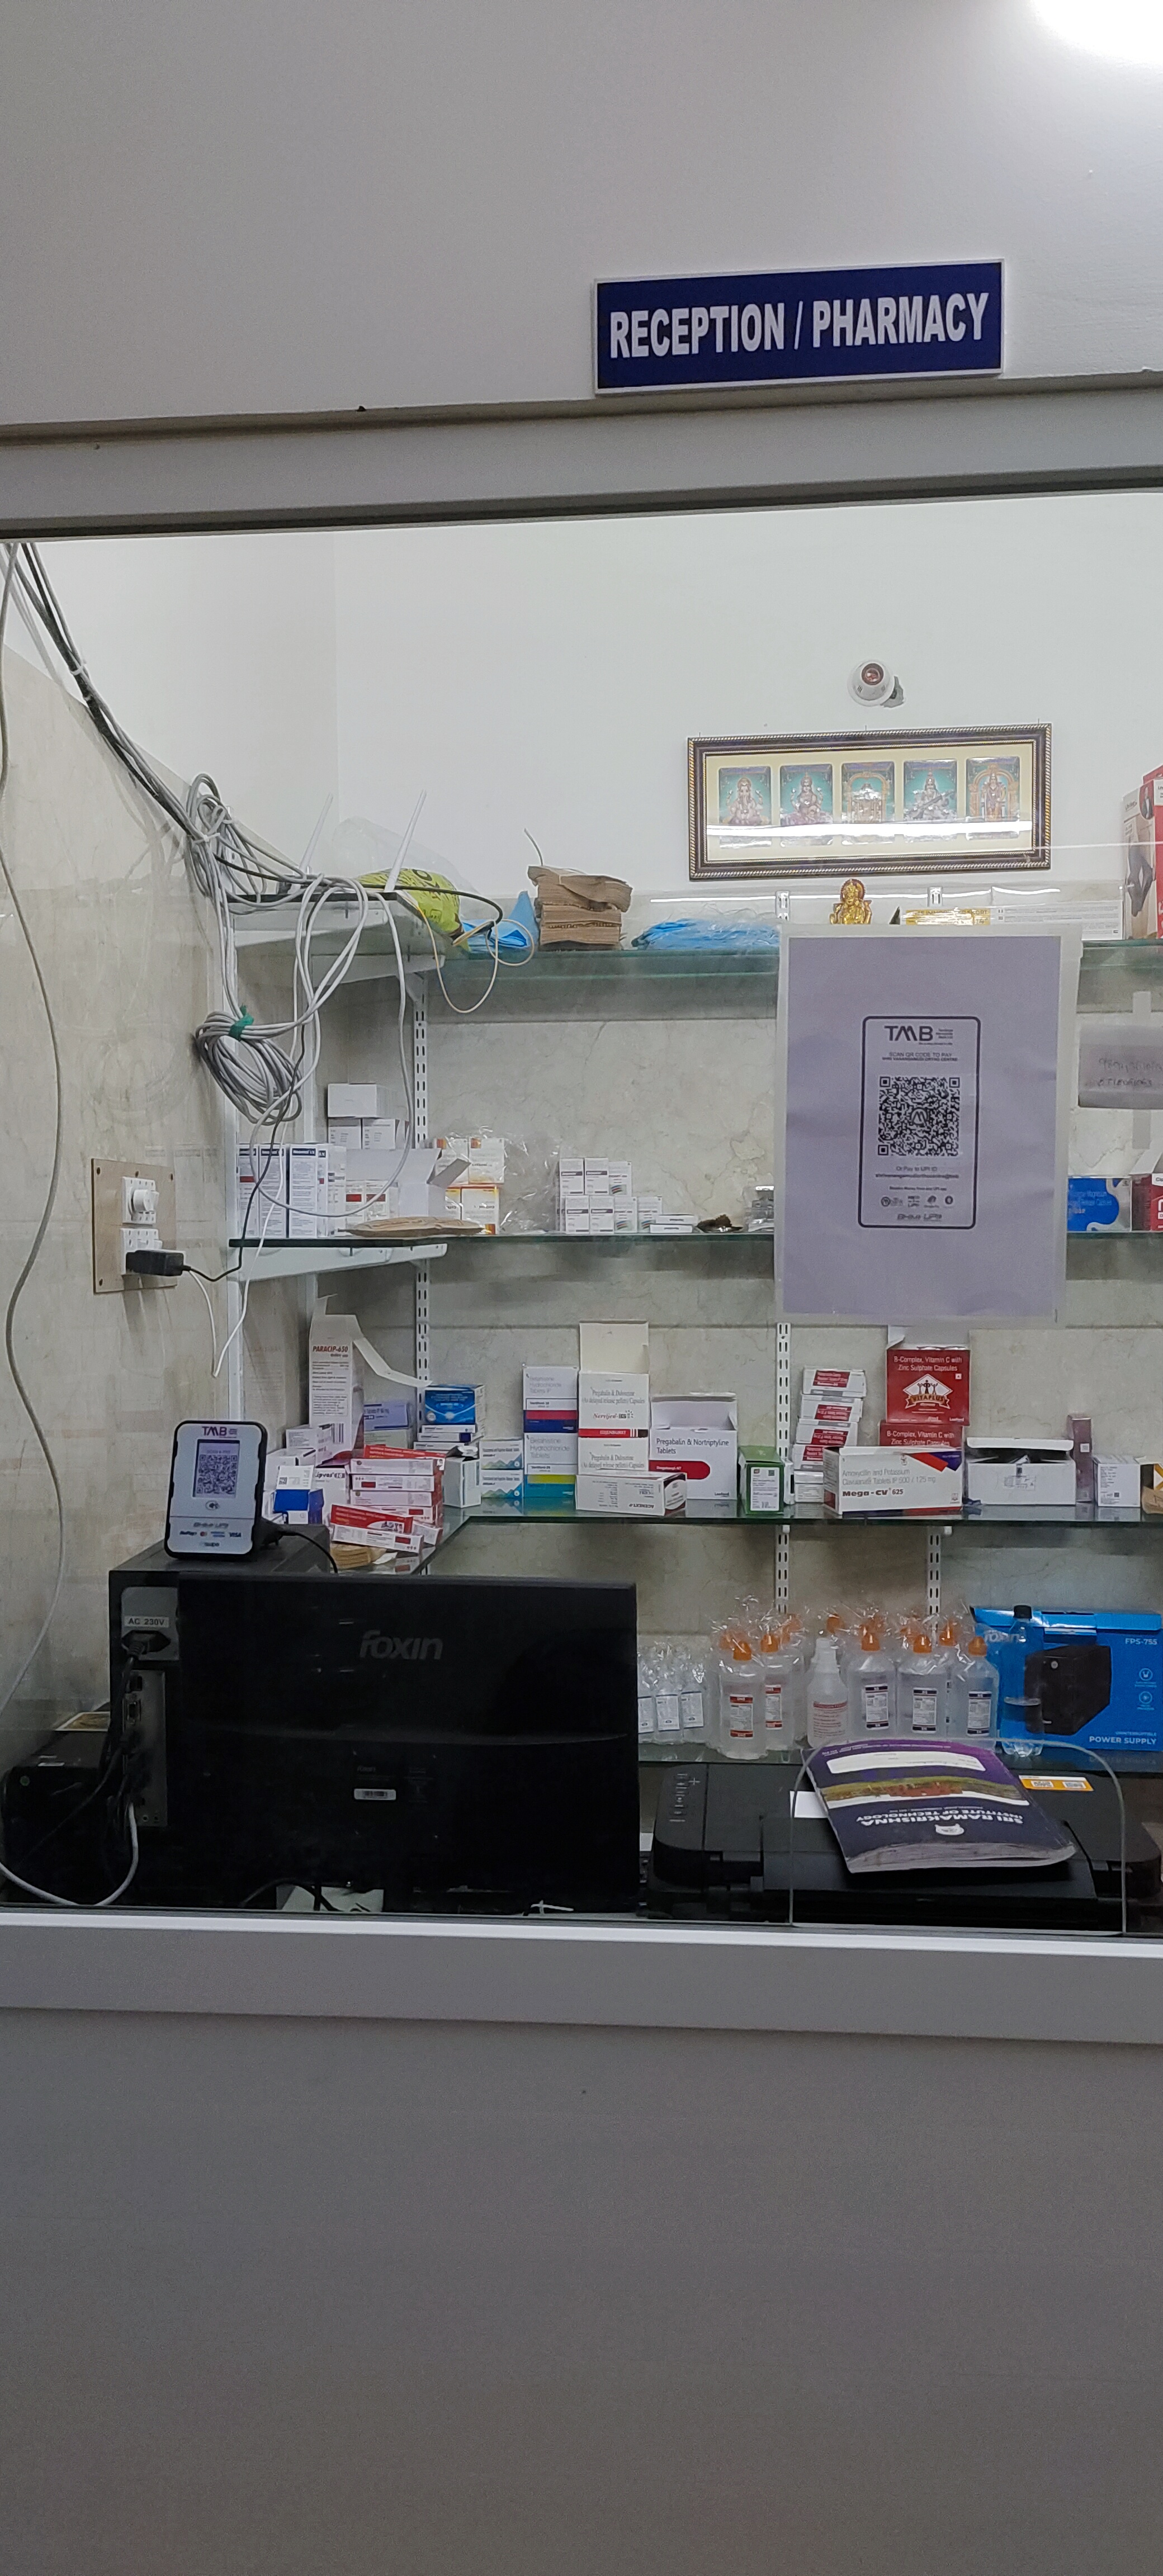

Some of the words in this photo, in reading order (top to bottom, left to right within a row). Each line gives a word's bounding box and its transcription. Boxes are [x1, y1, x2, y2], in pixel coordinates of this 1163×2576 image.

[610, 303, 784, 358] RECEPTION
[794, 301, 803, 349] /
[812, 292, 989, 348] PHARMACY
[883, 1025, 933, 1041] TMB
[202, 1426, 227, 1436] TMB
[656, 1438, 685, 1447] Pregabalin
[693, 1438, 729, 1447] Nortriptyline
[360, 1629, 443, 1660] foxin
[856, 1810, 940, 1822] TECHNOLOGY
[861, 1814, 994, 1826] RAMAKRISHNA
[965, 1809, 1023, 1820] INSTITUTE
[996, 1815, 1023, 1824] SRI
